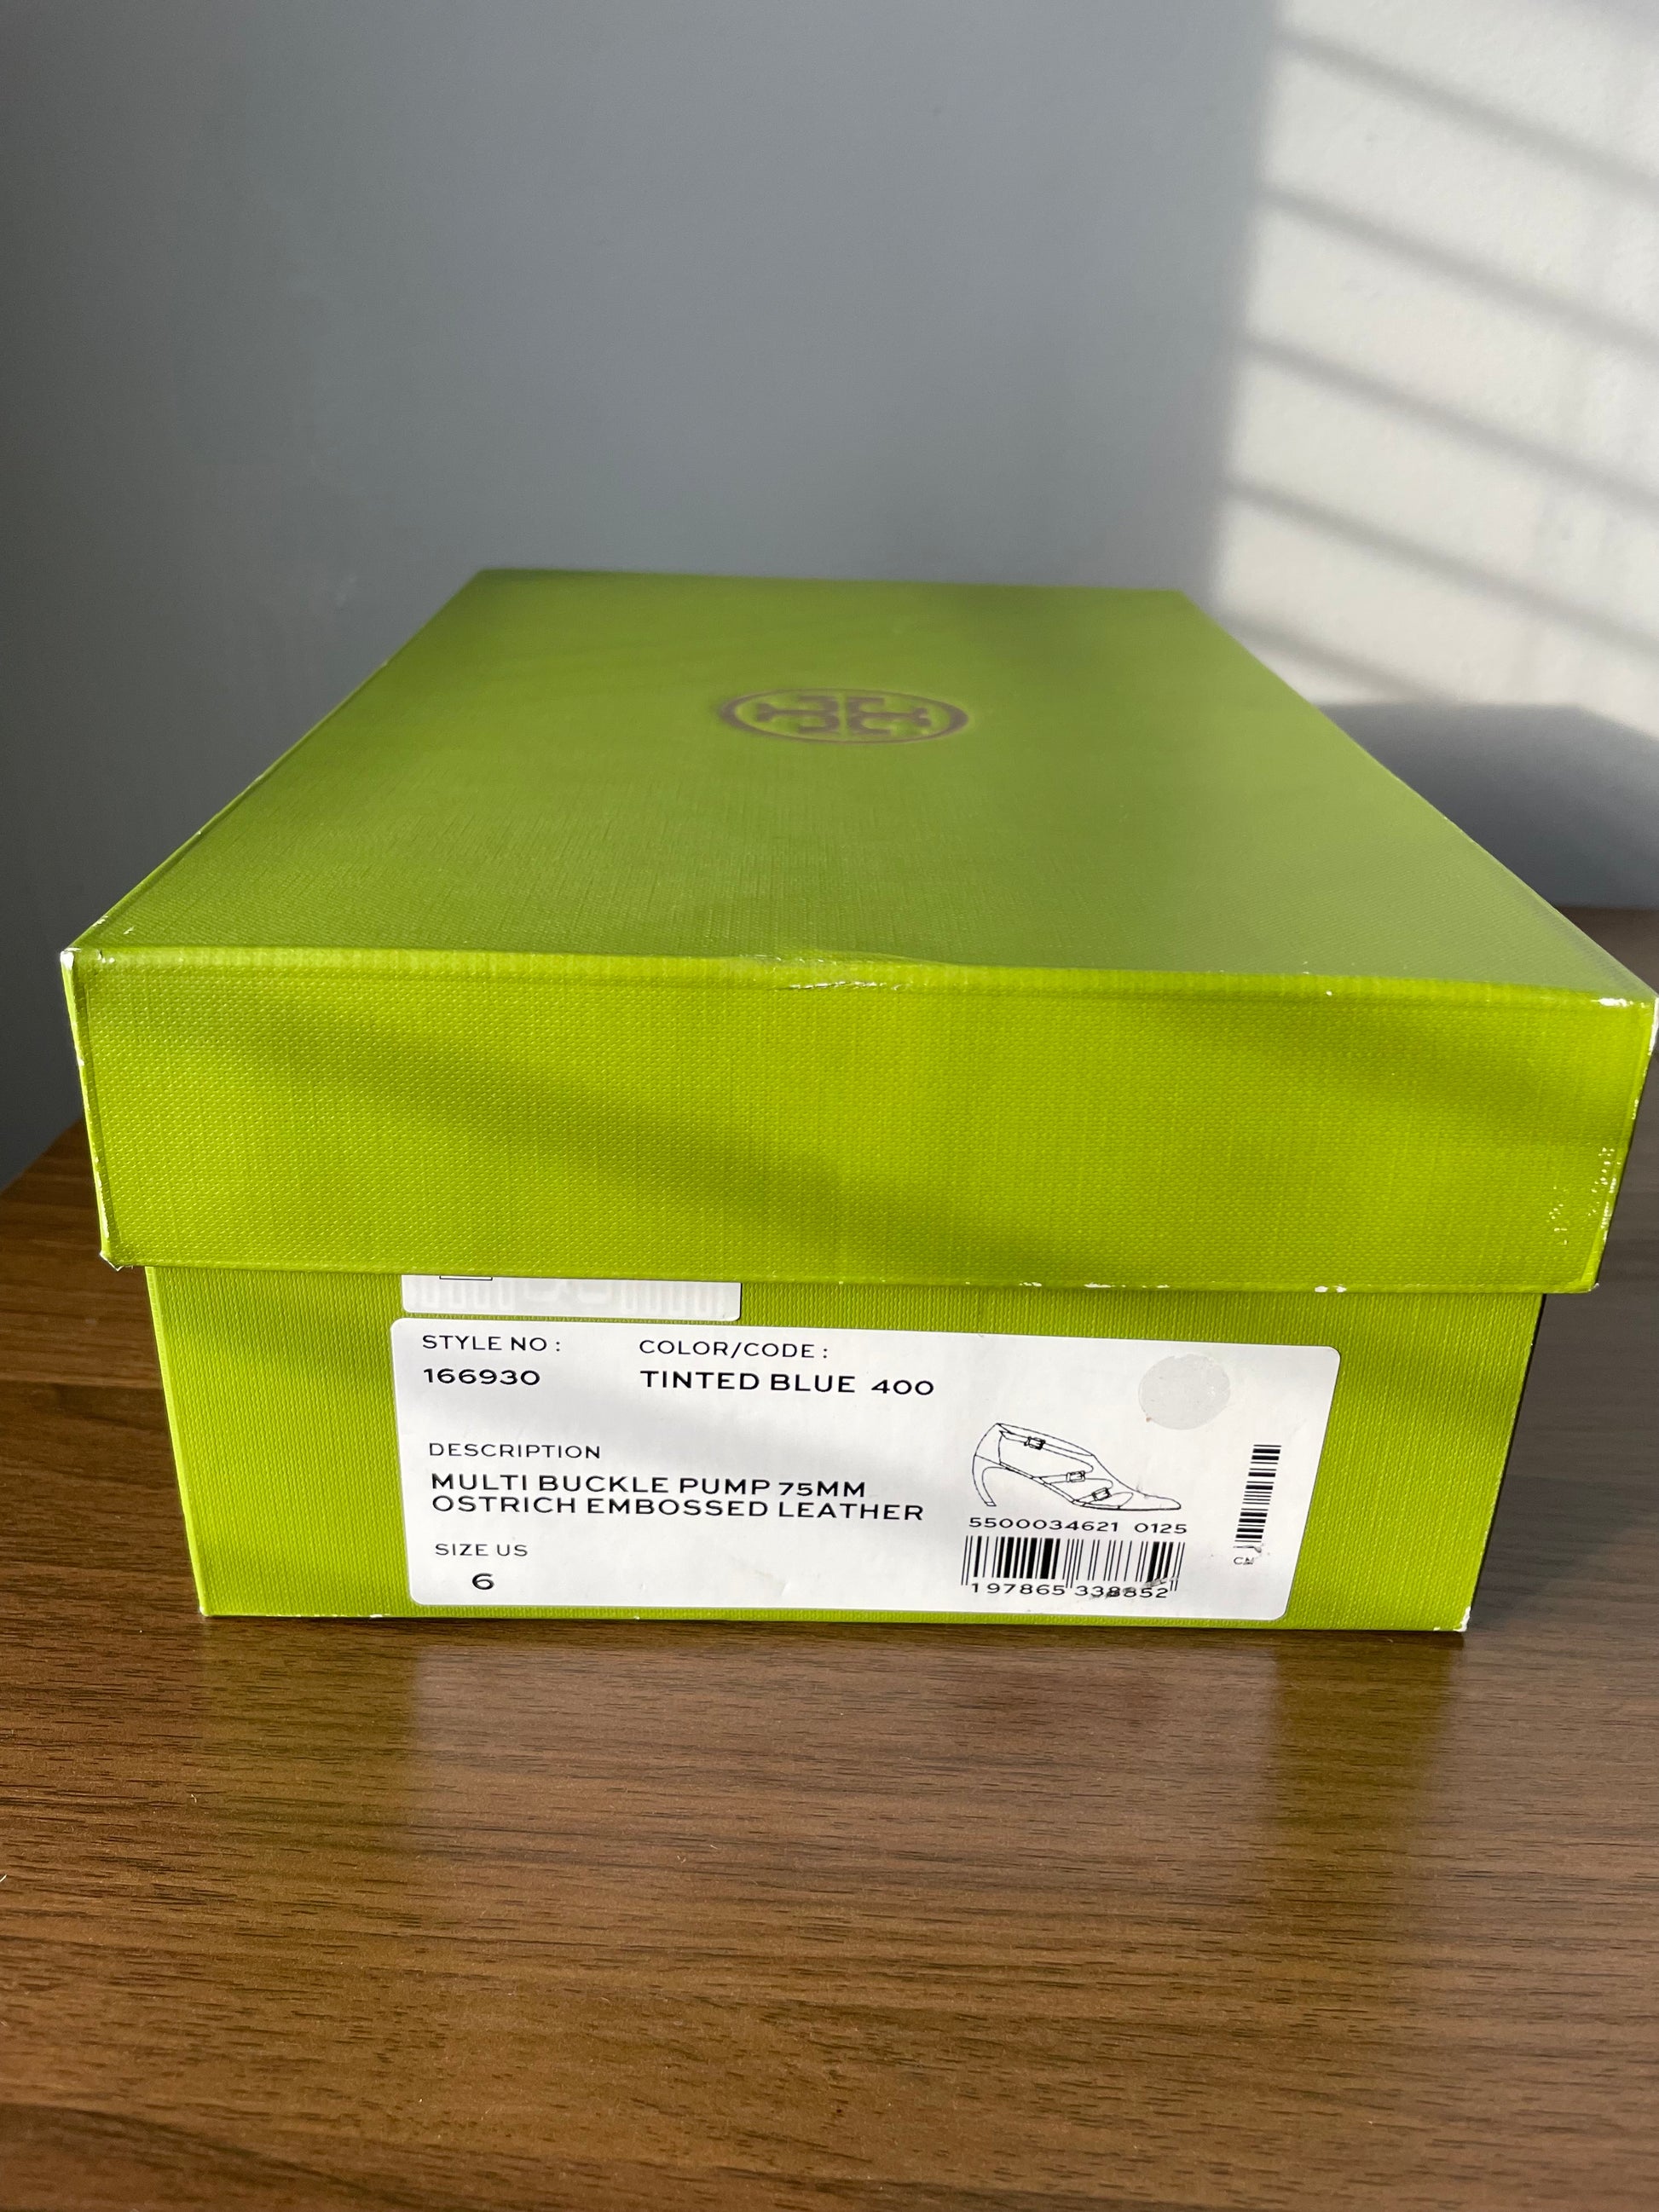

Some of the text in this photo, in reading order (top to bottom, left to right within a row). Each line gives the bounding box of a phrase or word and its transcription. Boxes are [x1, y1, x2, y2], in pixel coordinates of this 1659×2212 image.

[422, 1334, 503, 1351] STYLE
[510, 1336, 548, 1352] NO
[639, 1339, 815, 1360] COLOR/CODE
[423, 1367, 541, 1386] 166930
[639, 1370, 934, 1396] TINTED BLUE 400
[429, 1442, 600, 1459] DESCRIPTION
[431, 1472, 865, 1499] MULTI BUCKLE PUMP 75MM
[431, 1495, 924, 1522] OSTRICH EMBOSSED LEATHER
[968, 1516, 1188, 1535] 5500034621 0125
[435, 1543, 529, 1557] SIZE US
[471, 1572, 495, 1591] 6
